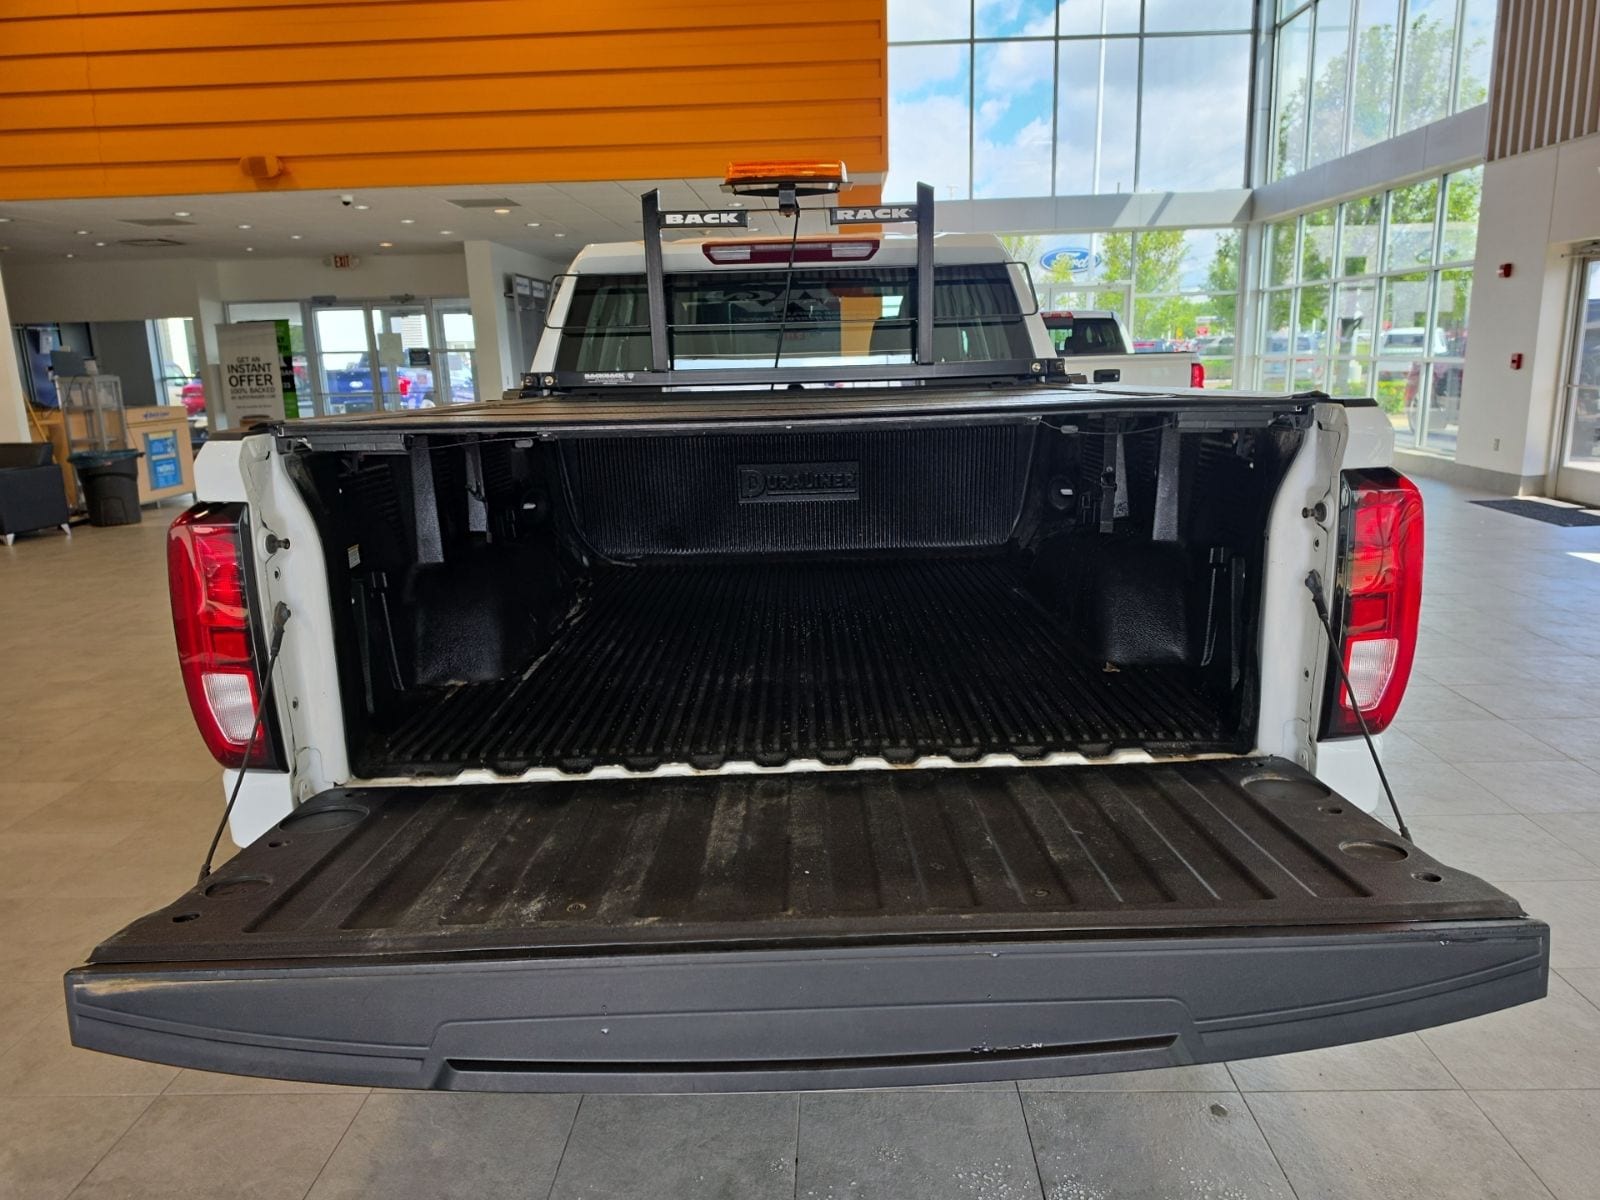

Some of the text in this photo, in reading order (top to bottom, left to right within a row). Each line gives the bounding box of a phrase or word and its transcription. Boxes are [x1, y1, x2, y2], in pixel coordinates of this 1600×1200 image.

[665, 213, 739, 225] BACK
[836, 208, 909, 220] RACK
[227, 363, 272, 374] INSTANT
[229, 374, 273, 388] OFFER
